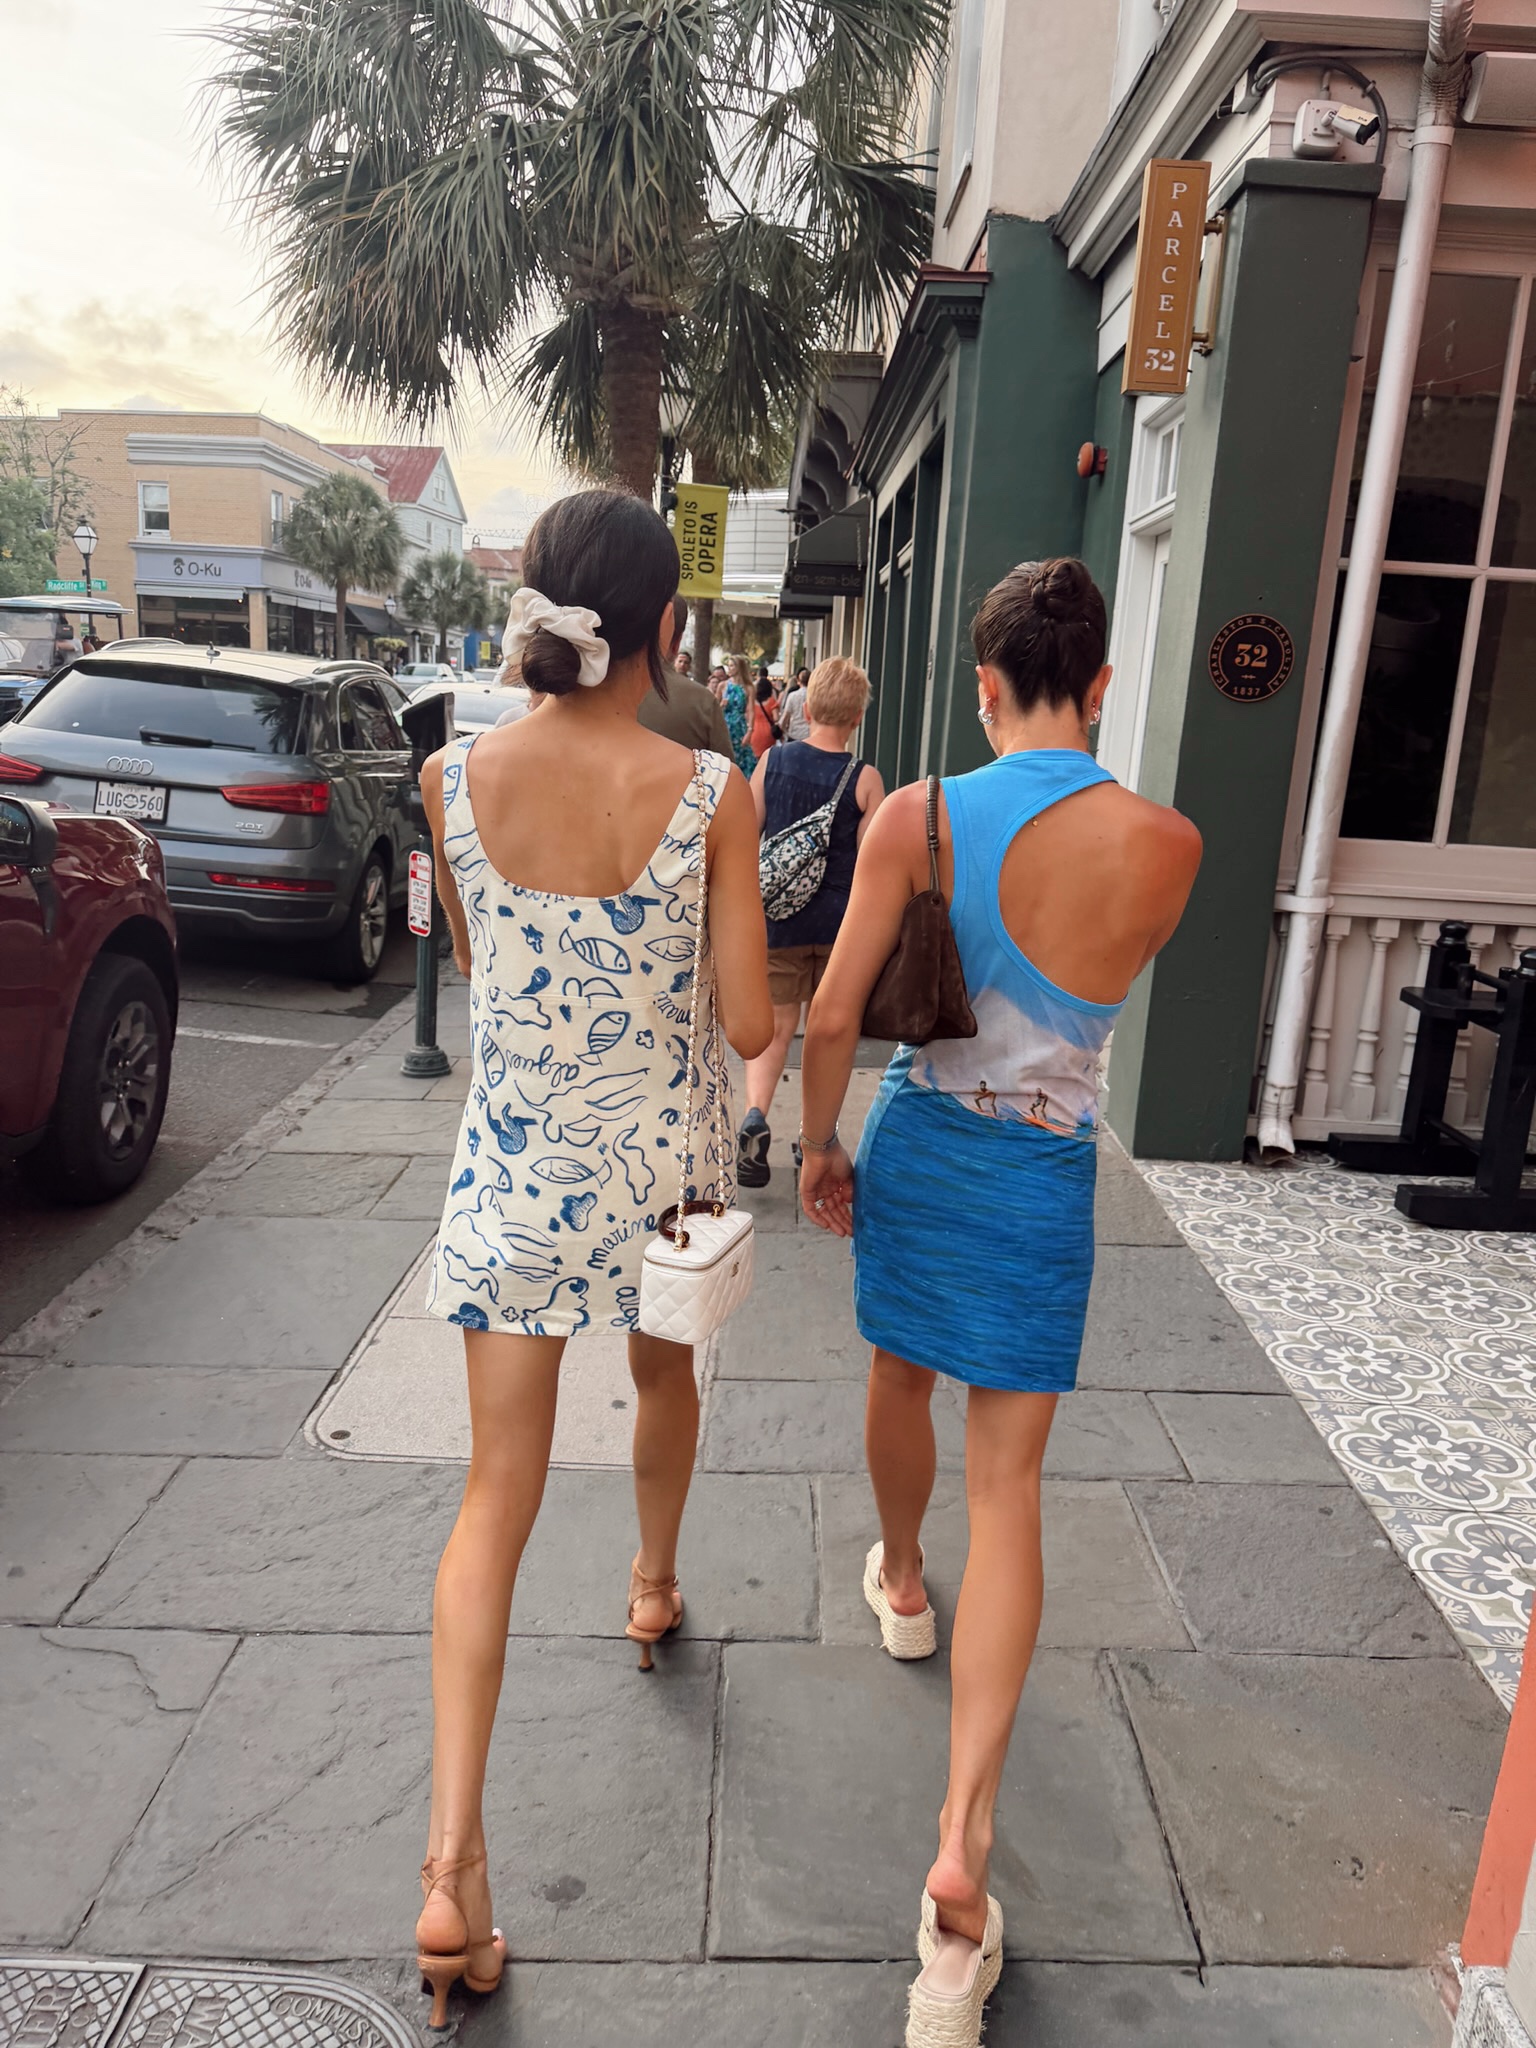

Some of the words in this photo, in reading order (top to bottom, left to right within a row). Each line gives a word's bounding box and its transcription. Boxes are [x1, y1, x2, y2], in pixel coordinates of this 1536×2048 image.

[1155, 182, 1188, 339] PARCEL
[1143, 348, 1176, 372] 32
[685, 501, 699, 515] IS
[681, 517, 698, 581] SPOLETO
[697, 511, 718, 574] OPERA
[188, 562, 222, 577] O-Ku
[48, 581, 78, 591] Radcliffe
[1210, 616, 1253, 685] CHARLESTON
[1273, 625, 1292, 687] CAROLINA
[1234, 643, 1269, 668] 32
[1232, 687, 1261, 696] 1837
[98, 790, 122, 807] LUG
[140, 794, 163, 811] 560
[587, 1213, 657, 1270] marine
